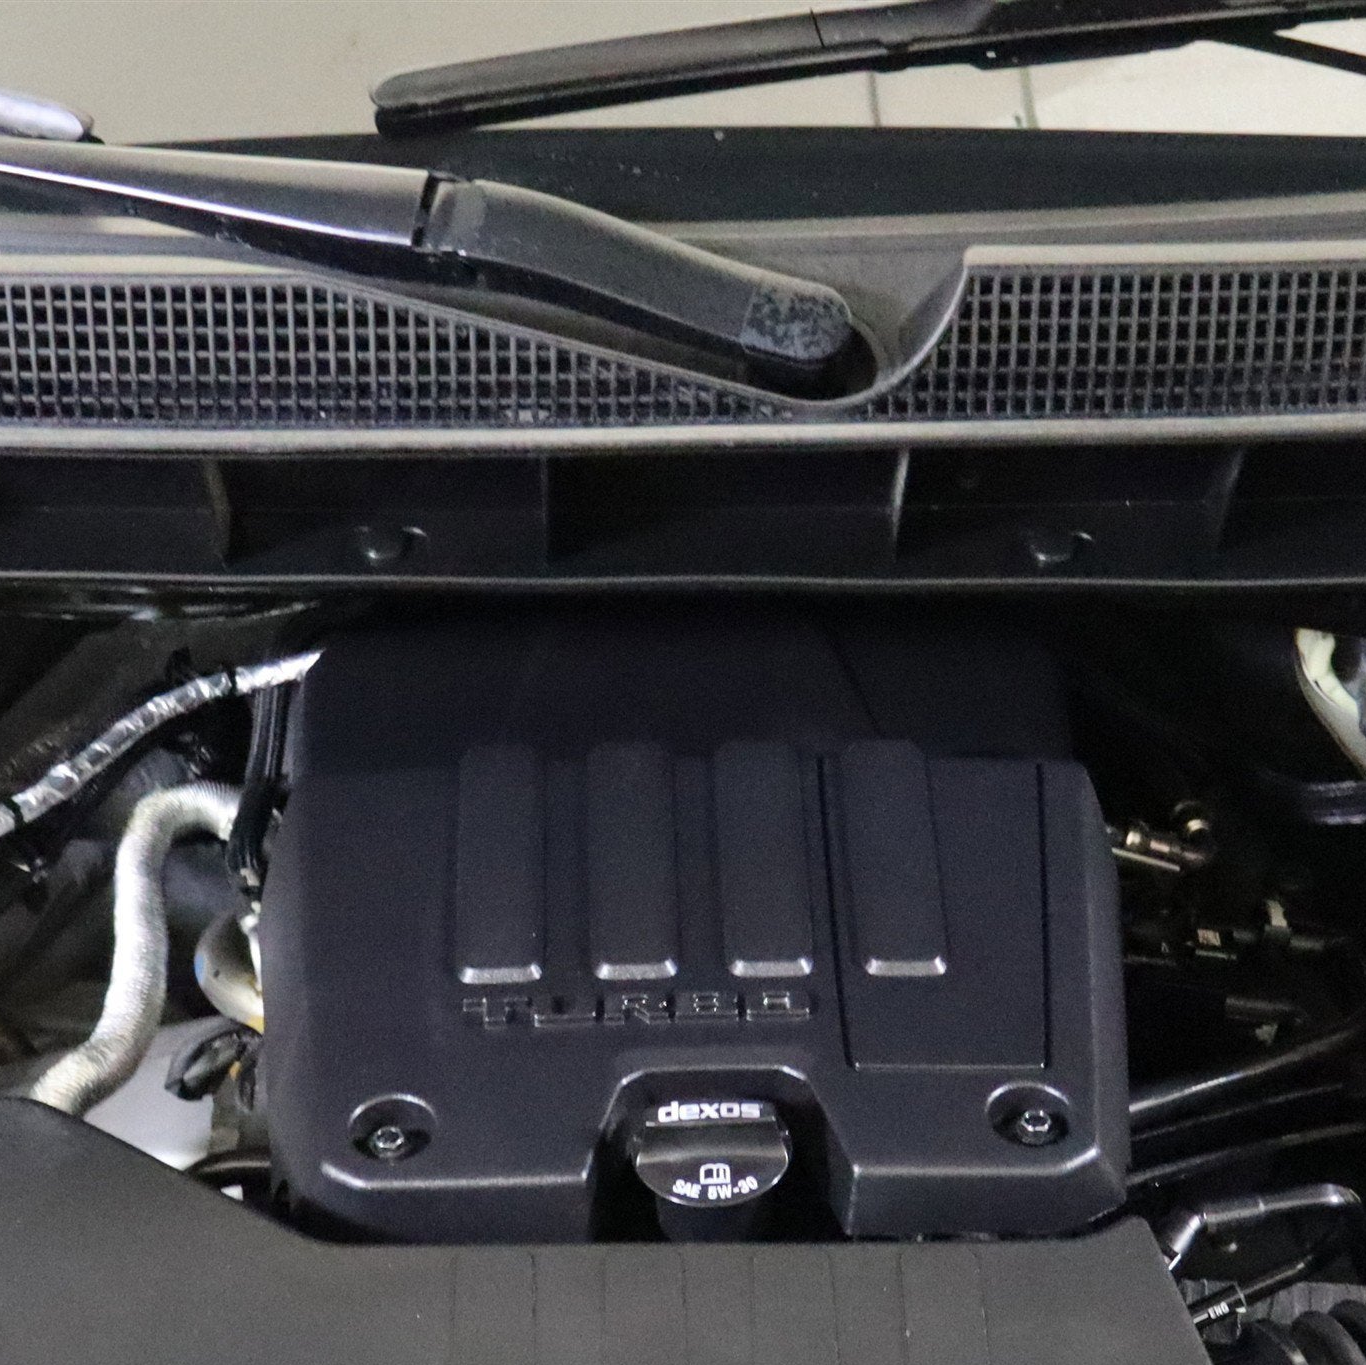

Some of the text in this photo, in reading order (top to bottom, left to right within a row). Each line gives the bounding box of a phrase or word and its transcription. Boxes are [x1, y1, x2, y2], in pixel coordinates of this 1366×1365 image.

[657, 1100, 761, 1123] dexos
[672, 1175, 759, 1200] SAE 5W-30
